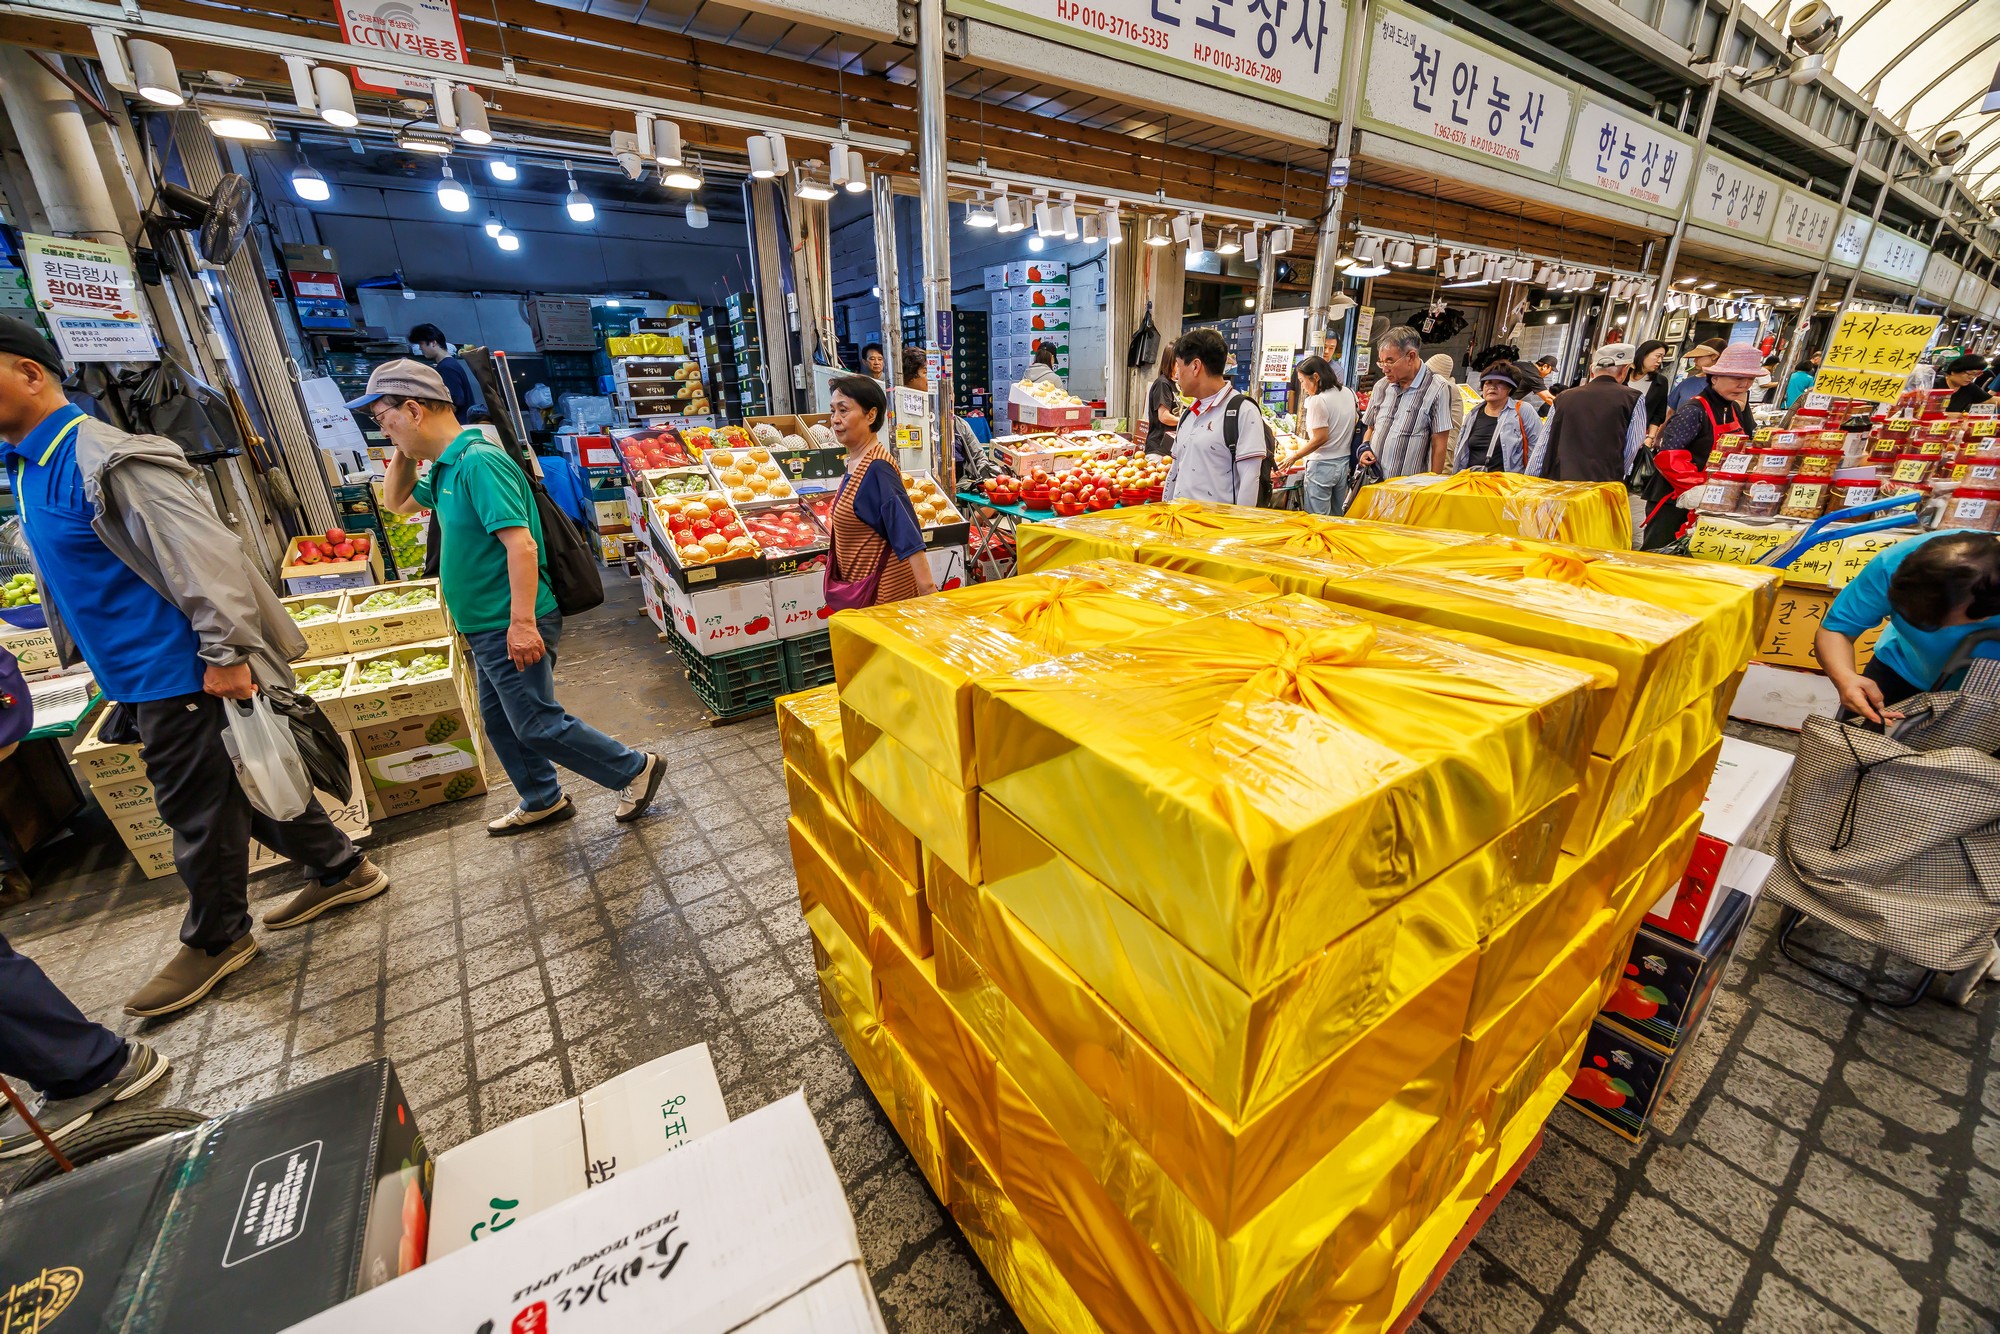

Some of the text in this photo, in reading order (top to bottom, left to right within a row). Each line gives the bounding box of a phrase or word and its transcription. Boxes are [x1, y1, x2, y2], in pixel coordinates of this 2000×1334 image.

[1057, 1, 1169, 50] H.P 010-3716-5335
[352, 25, 457, 61] CCTV 작동중
[1193, 42, 1282, 84] H.P 010-3126-7289
[1410, 43, 1544, 148] 천안농산
[1434, 123, 1467, 144] T.962-6576
[1596, 122, 1678, 194] 한농상회
[1711, 172, 1767, 224] 우성상회
[43, 260, 119, 286] 환급행사
[47, 278, 122, 302] 참여점포
[1692, 541, 1747, 563] 조개젓
[778, 561, 798, 572] 사과
[785, 610, 814, 625] 사과
[352, 637, 381, 646] 샤인머스켓
[710, 625, 741, 641] 사과
[357, 711, 388, 721] 샤인머스켓
[96, 765, 136, 780] 샤인머스켓
[114, 797, 153, 810] 샤인머스켓
[135, 828, 172, 841] 샤인머스켓
[511, 1210, 680, 1304] FRESH YEONGJU APPLE
